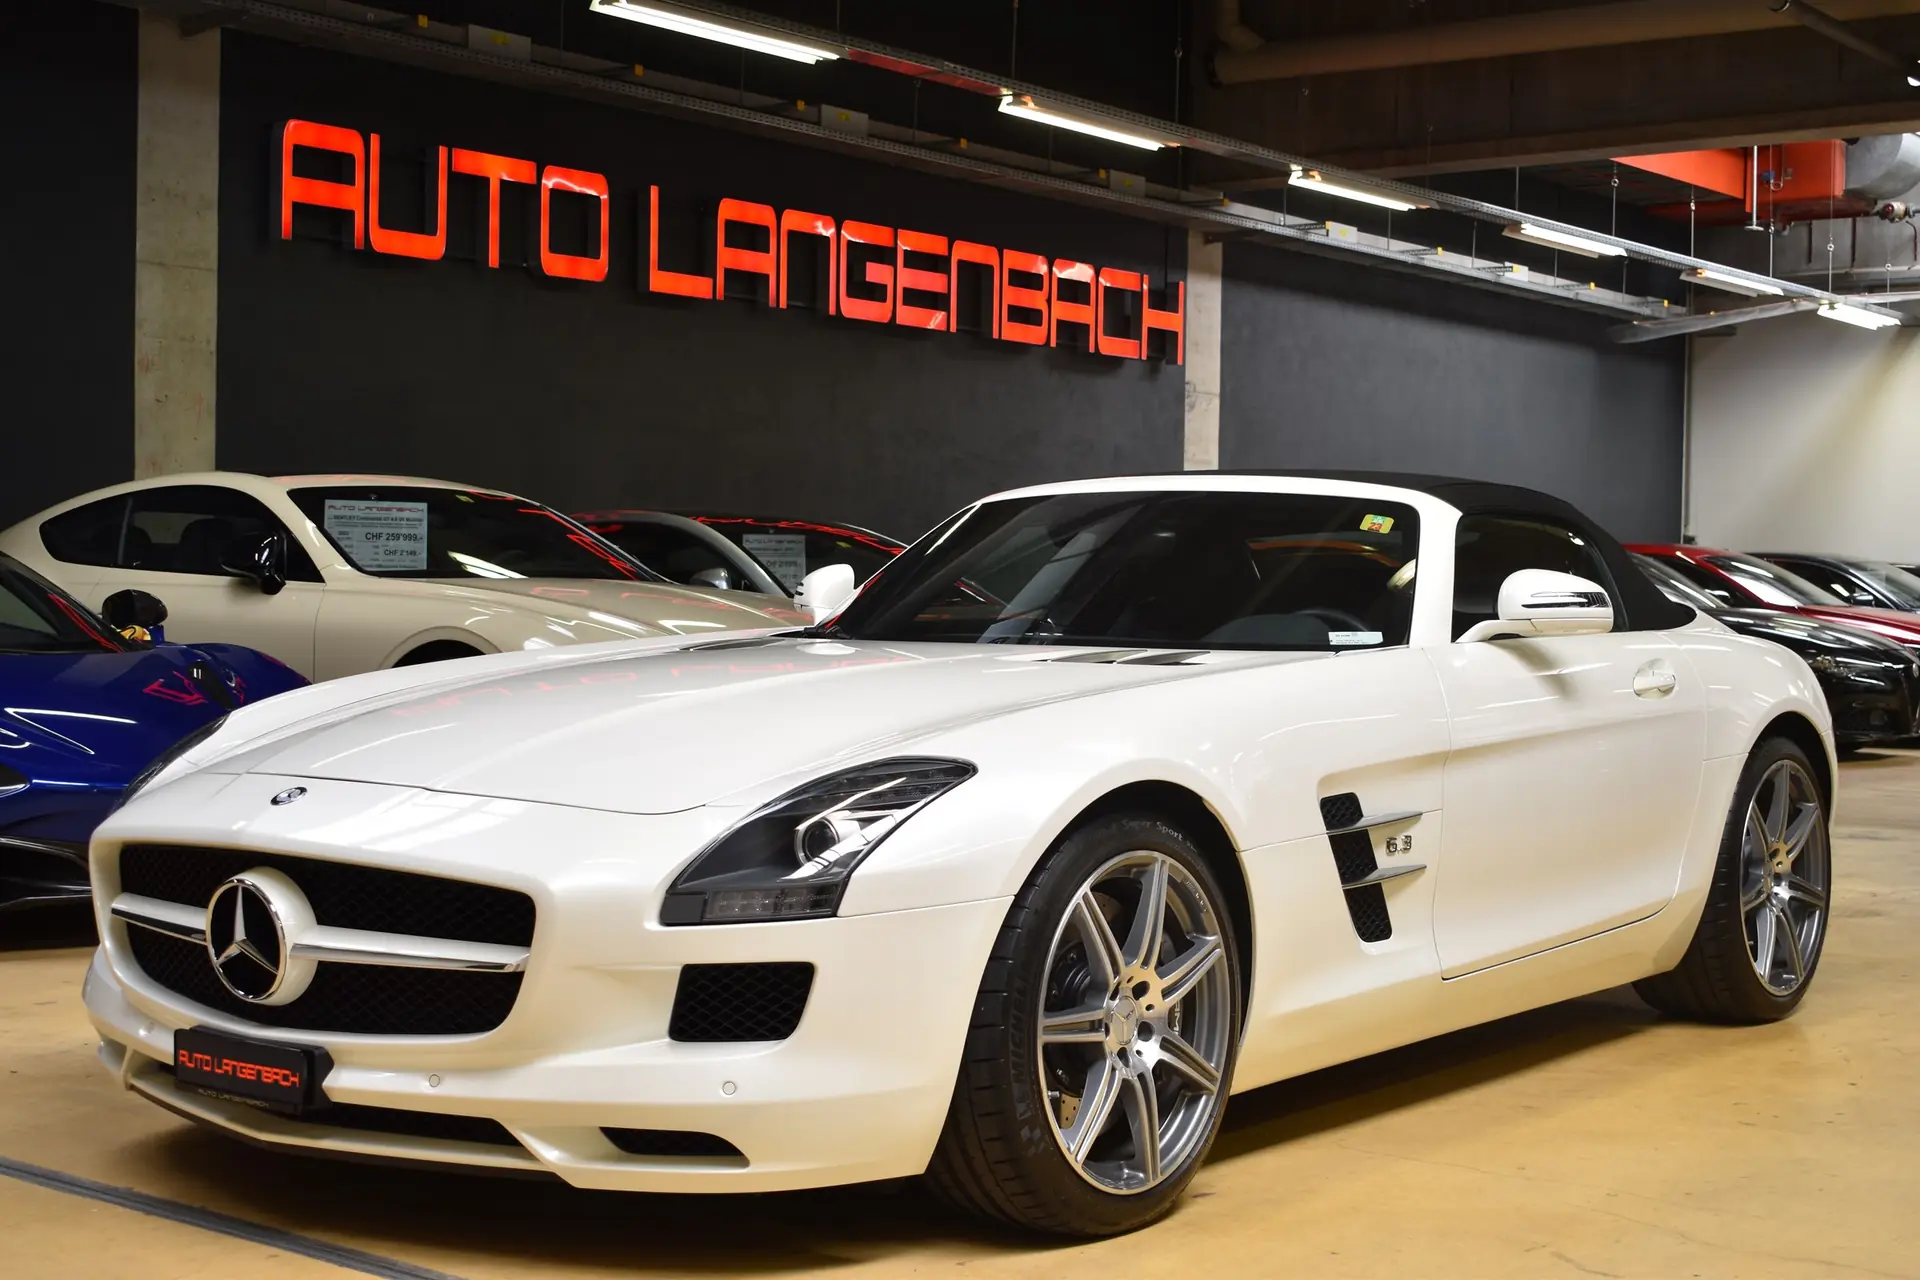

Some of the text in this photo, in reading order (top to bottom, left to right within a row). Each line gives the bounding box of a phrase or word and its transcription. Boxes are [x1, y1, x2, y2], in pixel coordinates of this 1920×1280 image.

[281, 118, 1185, 366] AUTO LANGENBACH
[365, 532, 383, 541] CHF
[1155, 820, 1184, 842] Sport
[179, 1049, 300, 1088] AUTO LANGENBACH
